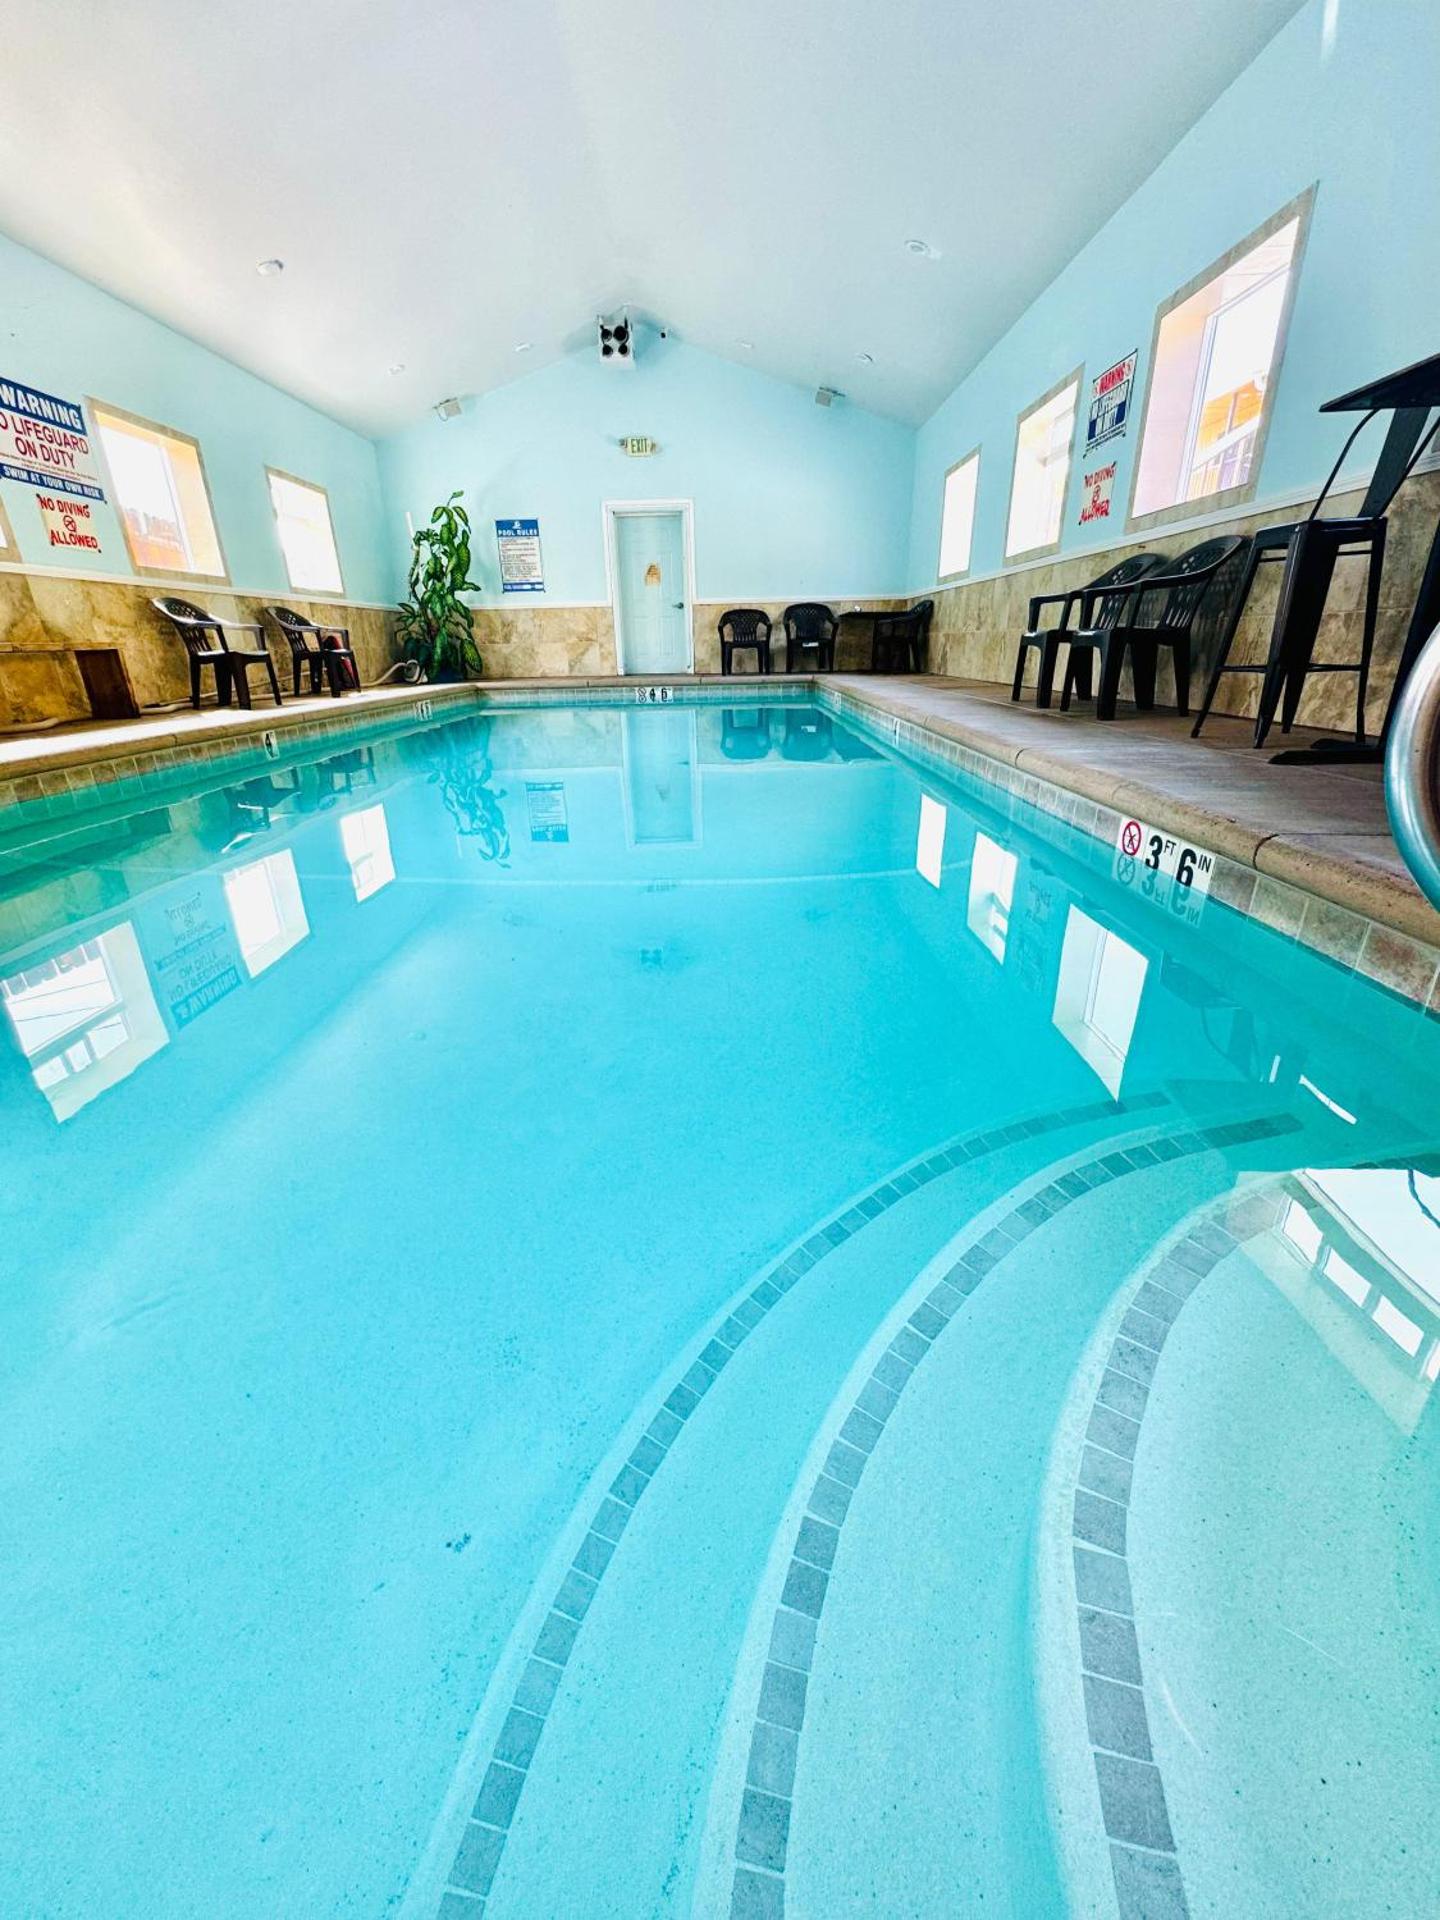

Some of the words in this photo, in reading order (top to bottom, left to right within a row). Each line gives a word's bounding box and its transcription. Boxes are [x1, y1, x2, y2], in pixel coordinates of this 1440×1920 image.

[0, 383, 82, 430] WARNING
[11, 414, 89, 455] LIFEGUARD
[630, 438, 648, 454] EXIT
[15, 436, 38, 459] ON
[40, 443, 75, 469] DUTY
[3, 465, 29, 481] SWIM
[30, 472, 41, 484] AT
[41, 475, 65, 490] YOUR
[64, 481, 83, 494] OWN
[82, 485, 101, 498] RISK
[39, 496, 55, 511] NO
[56, 499, 90, 518] DIVING
[50, 529, 98, 548] ALLOWED
[1145, 835, 1163, 870] 3
[1164, 840, 1177, 856] FT
[1176, 848, 1198, 888] 6
[1197, 854, 1212, 873] IN
